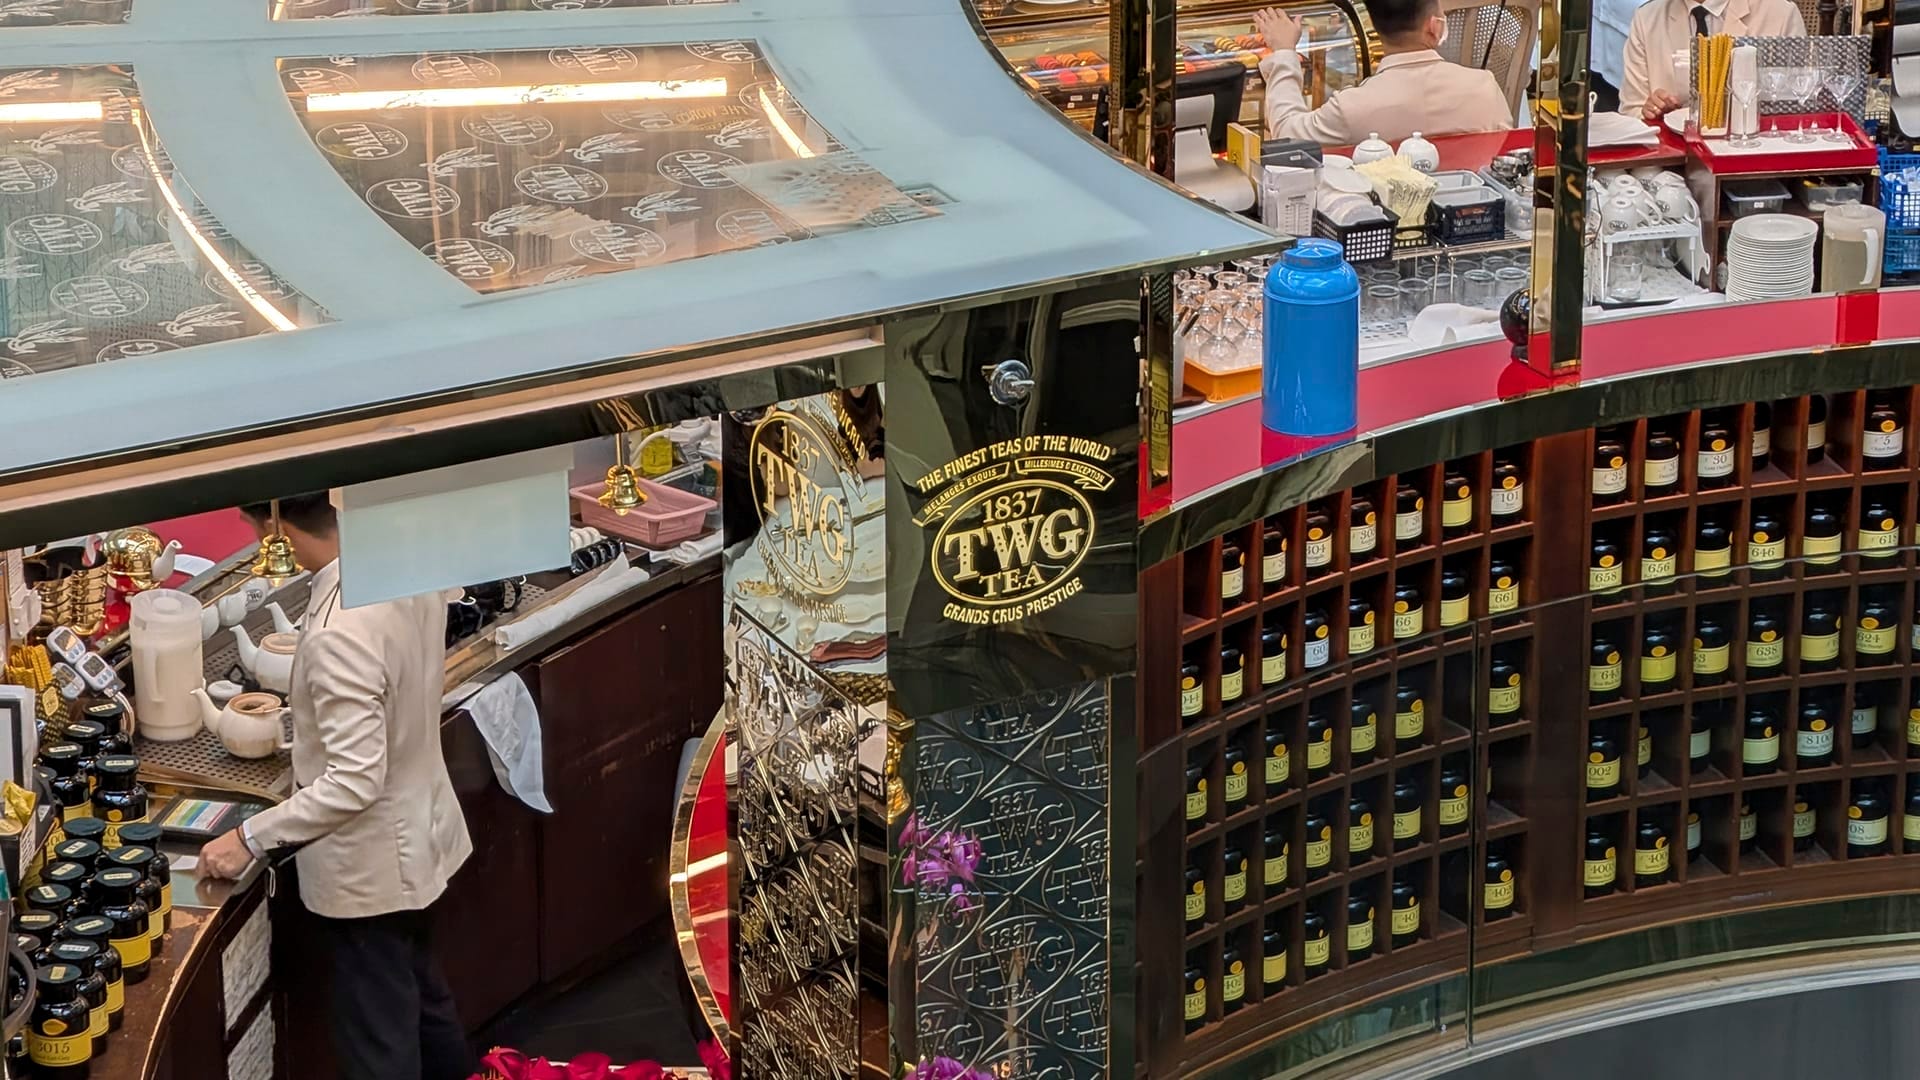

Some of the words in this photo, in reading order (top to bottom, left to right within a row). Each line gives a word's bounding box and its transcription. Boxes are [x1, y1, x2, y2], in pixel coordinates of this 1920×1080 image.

[333, 123, 389, 157] TWG
[385, 181, 443, 216] TWG
[520, 178, 546, 195] TEA
[531, 166, 591, 201] TWG
[29, 217, 83, 252] TWG
[590, 226, 648, 261] TWG
[435, 240, 495, 276] TWG
[70, 278, 129, 315] TWG
[780, 424, 820, 478] 1837
[916, 466, 944, 493] THE
[944, 447, 988, 478] FINEST
[989, 437, 1022, 460] TEAS
[1024, 435, 1041, 451] OF
[1043, 435, 1068, 452] THE
[1069, 436, 1111, 461] WORLD
[757, 441, 849, 567] TWG
[923, 479, 966, 516] MELANGES
[967, 468, 998, 486] EXQUIS
[982, 487, 1043, 524] 1837
[781, 527, 823, 586] TEA
[944, 507, 1085, 582] TWG
[978, 561, 1046, 598] TEA
[1595, 571, 1618, 583] 658
[1648, 561, 1671, 574] 656
[942, 602, 990, 625] GRANDS
[991, 604, 1023, 624] CRUS
[1026, 576, 1083, 617] PRESTIGE
